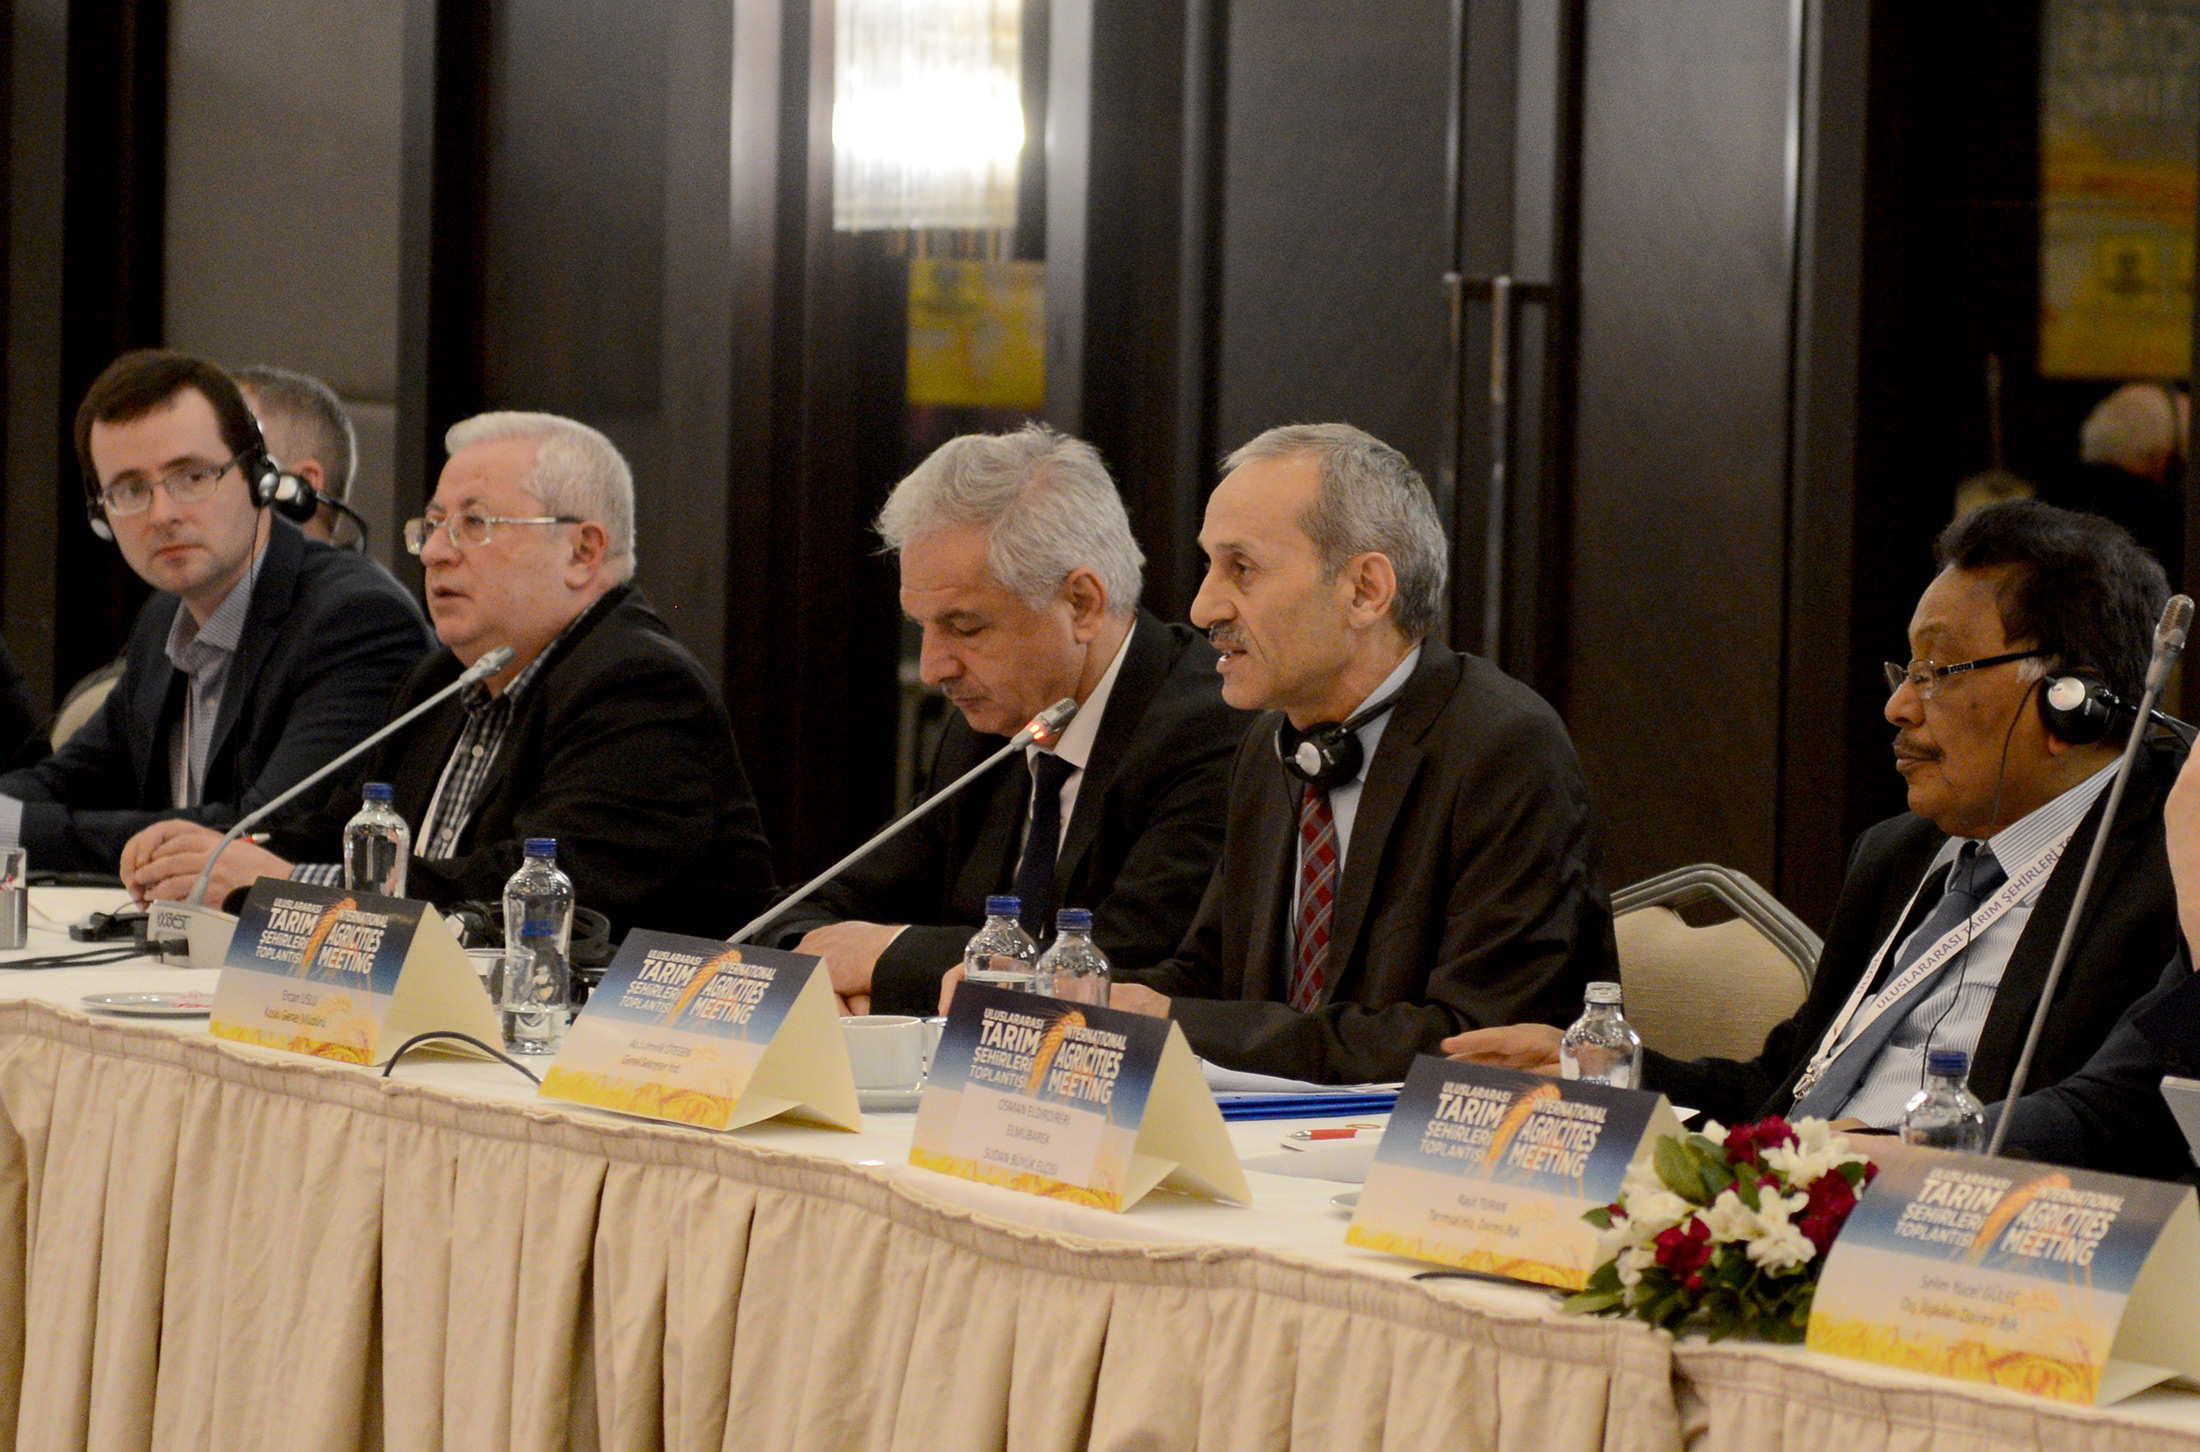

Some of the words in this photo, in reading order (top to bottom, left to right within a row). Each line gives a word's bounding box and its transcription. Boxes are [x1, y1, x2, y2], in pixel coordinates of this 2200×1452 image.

[267, 908, 319, 936] TARIM
[338, 909, 388, 928] INTERNATIONAL
[1877, 934, 1963, 1009] ULUSLARARASI
[1962, 901, 2003, 936] TARIM
[2002, 848, 2060, 903] ŞEHİRLERİ
[325, 922, 385, 953] AGRICITIES
[317, 946, 376, 974] MEETING
[637, 959, 697, 986] TARIM
[717, 961, 777, 981] INTERNATIONAL
[703, 975, 770, 1004] AGRICITIES
[689, 997, 755, 1024] MEETING
[980, 1019, 1041, 1055] TARIM
[1063, 1024, 1128, 1050] INTERNATIONAL
[1054, 1041, 1124, 1080] AGRICITIES
[1047, 1070, 1114, 1104] MEETING
[998, 1099, 1026, 1115] OSMAN
[1435, 1092, 1507, 1129] TARIM
[1532, 1098, 1608, 1124] INTERNATIONAL
[1516, 1114, 1602, 1153] AGRICITIES
[984, 1147, 1009, 1163] SUDAN
[1507, 1142, 1589, 1178] MEETING
[1917, 1178, 2004, 1214] TARIM
[2035, 1187, 2125, 1212] INTERNATIONAL
[2013, 1201, 2116, 1240] AGRICITIES
[2001, 1227, 2099, 1265] MEETING
